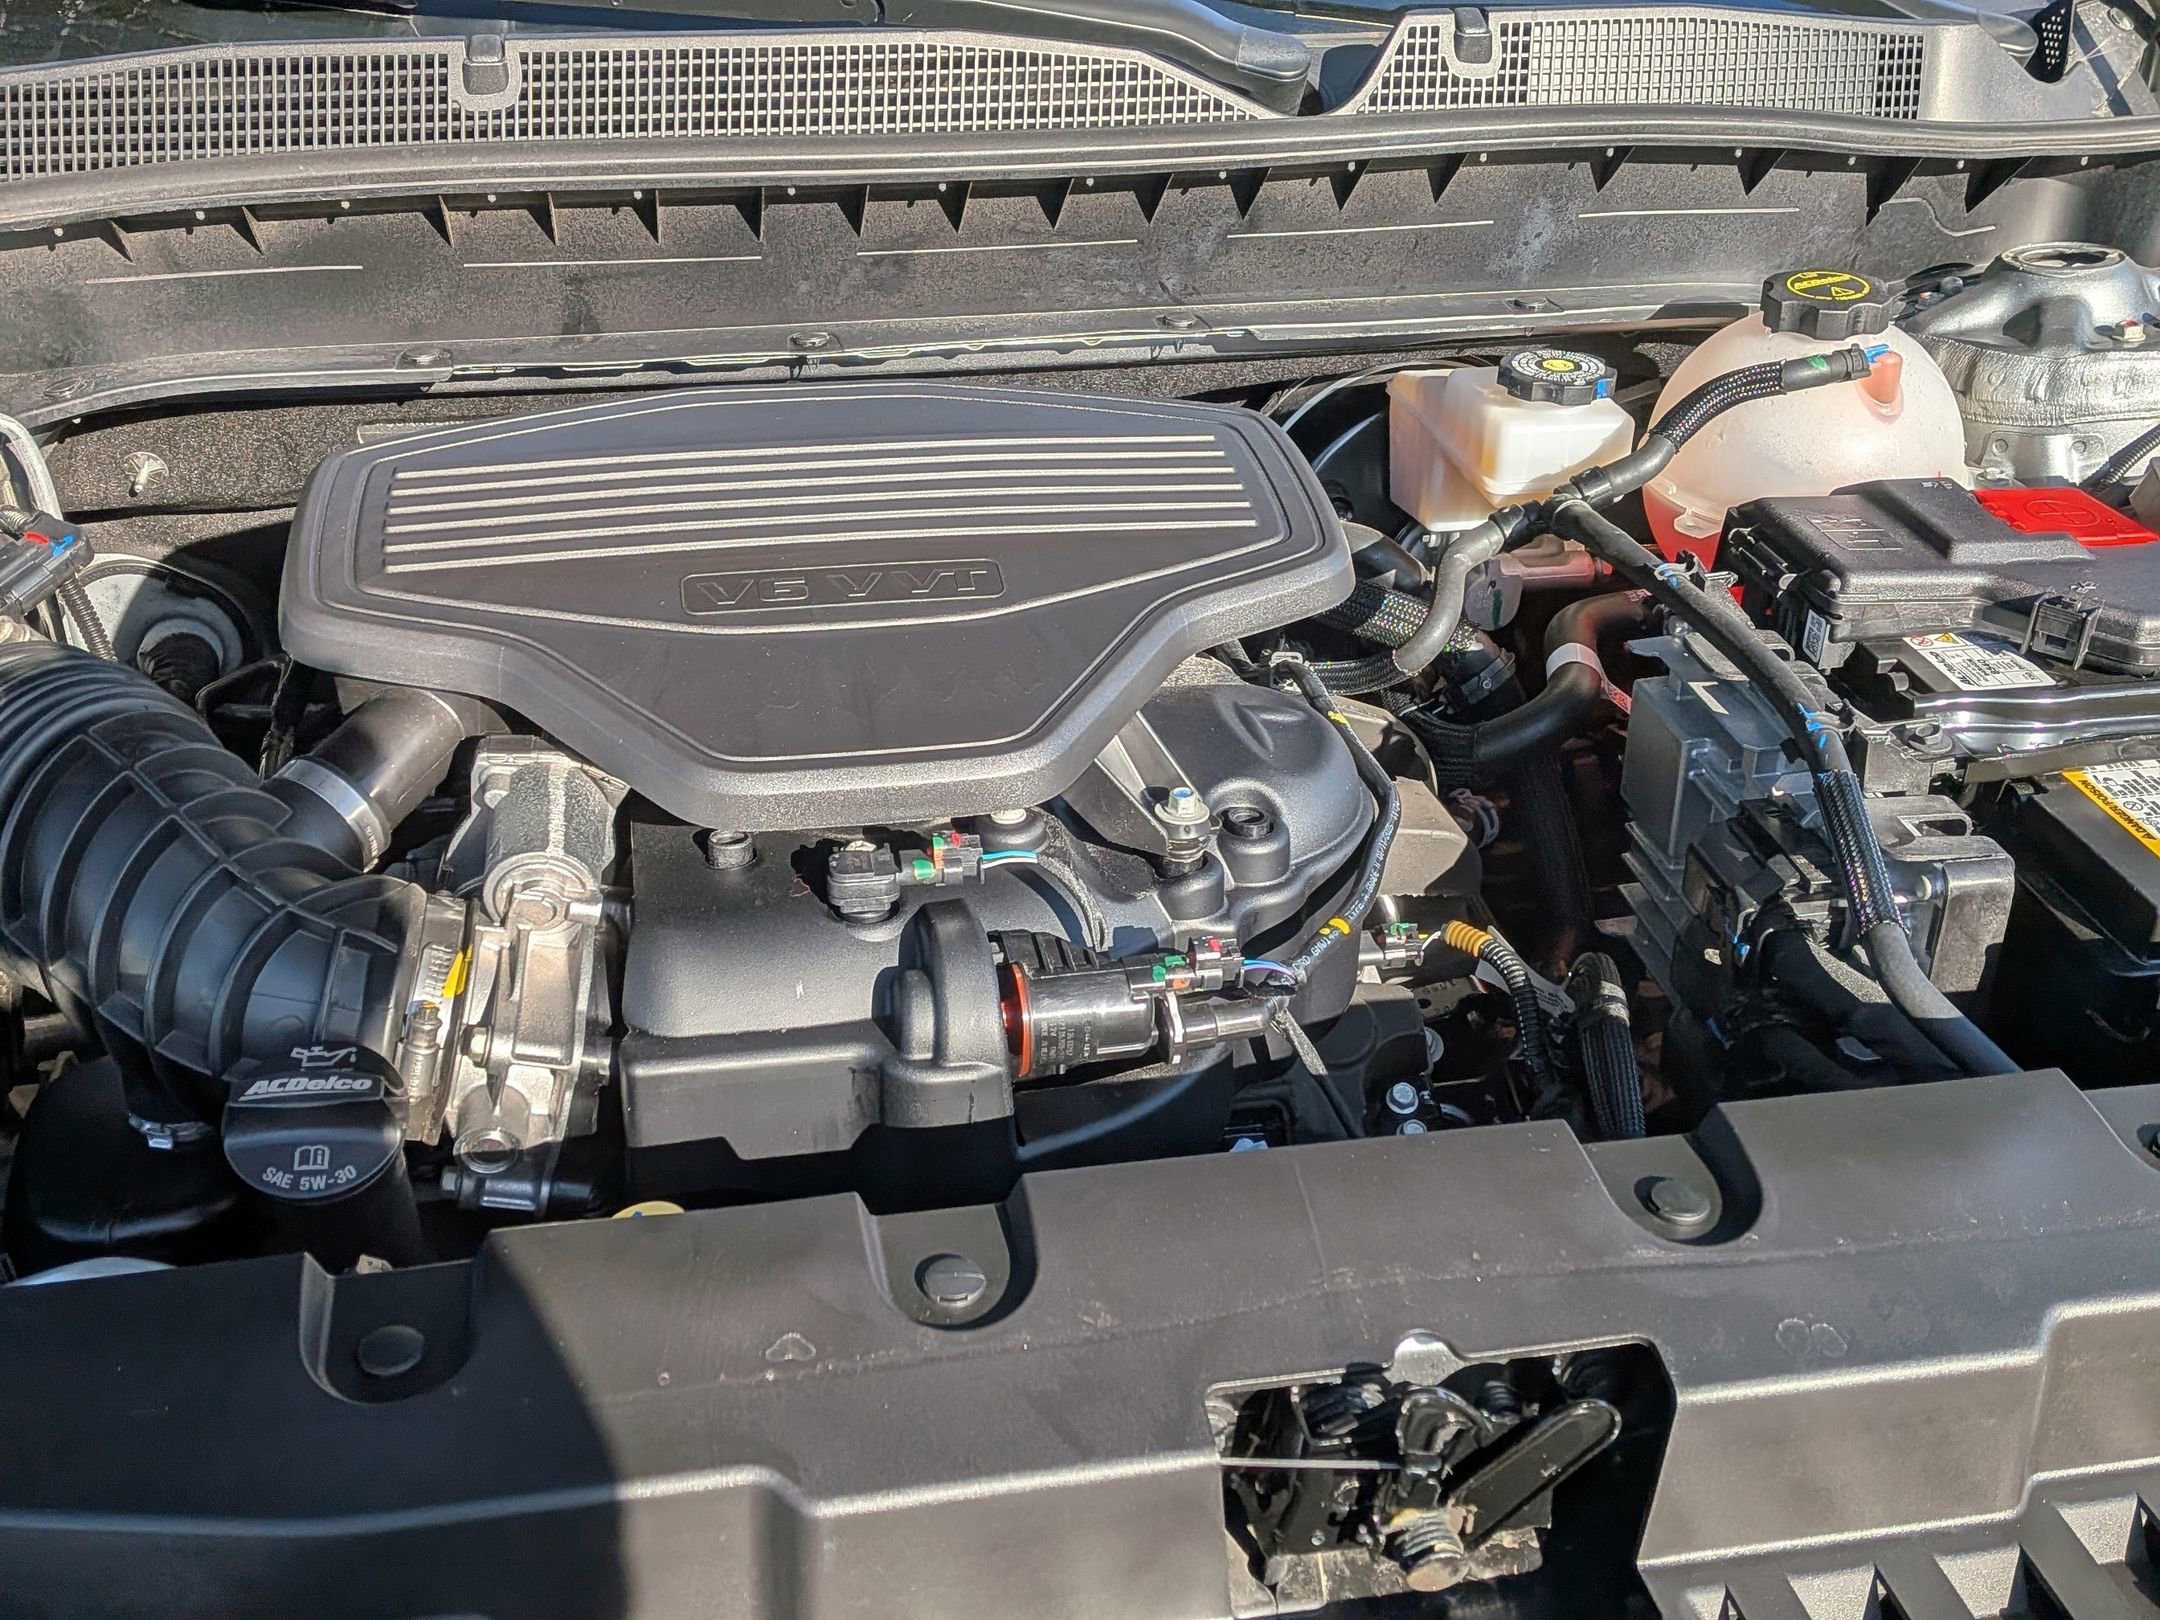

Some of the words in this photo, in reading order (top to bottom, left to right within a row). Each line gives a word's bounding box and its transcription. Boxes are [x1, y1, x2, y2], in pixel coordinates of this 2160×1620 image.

[244, 1075, 373, 1096] ACDelco
[262, 1166, 294, 1189] SAE
[300, 1165, 357, 1191] 5W-30
